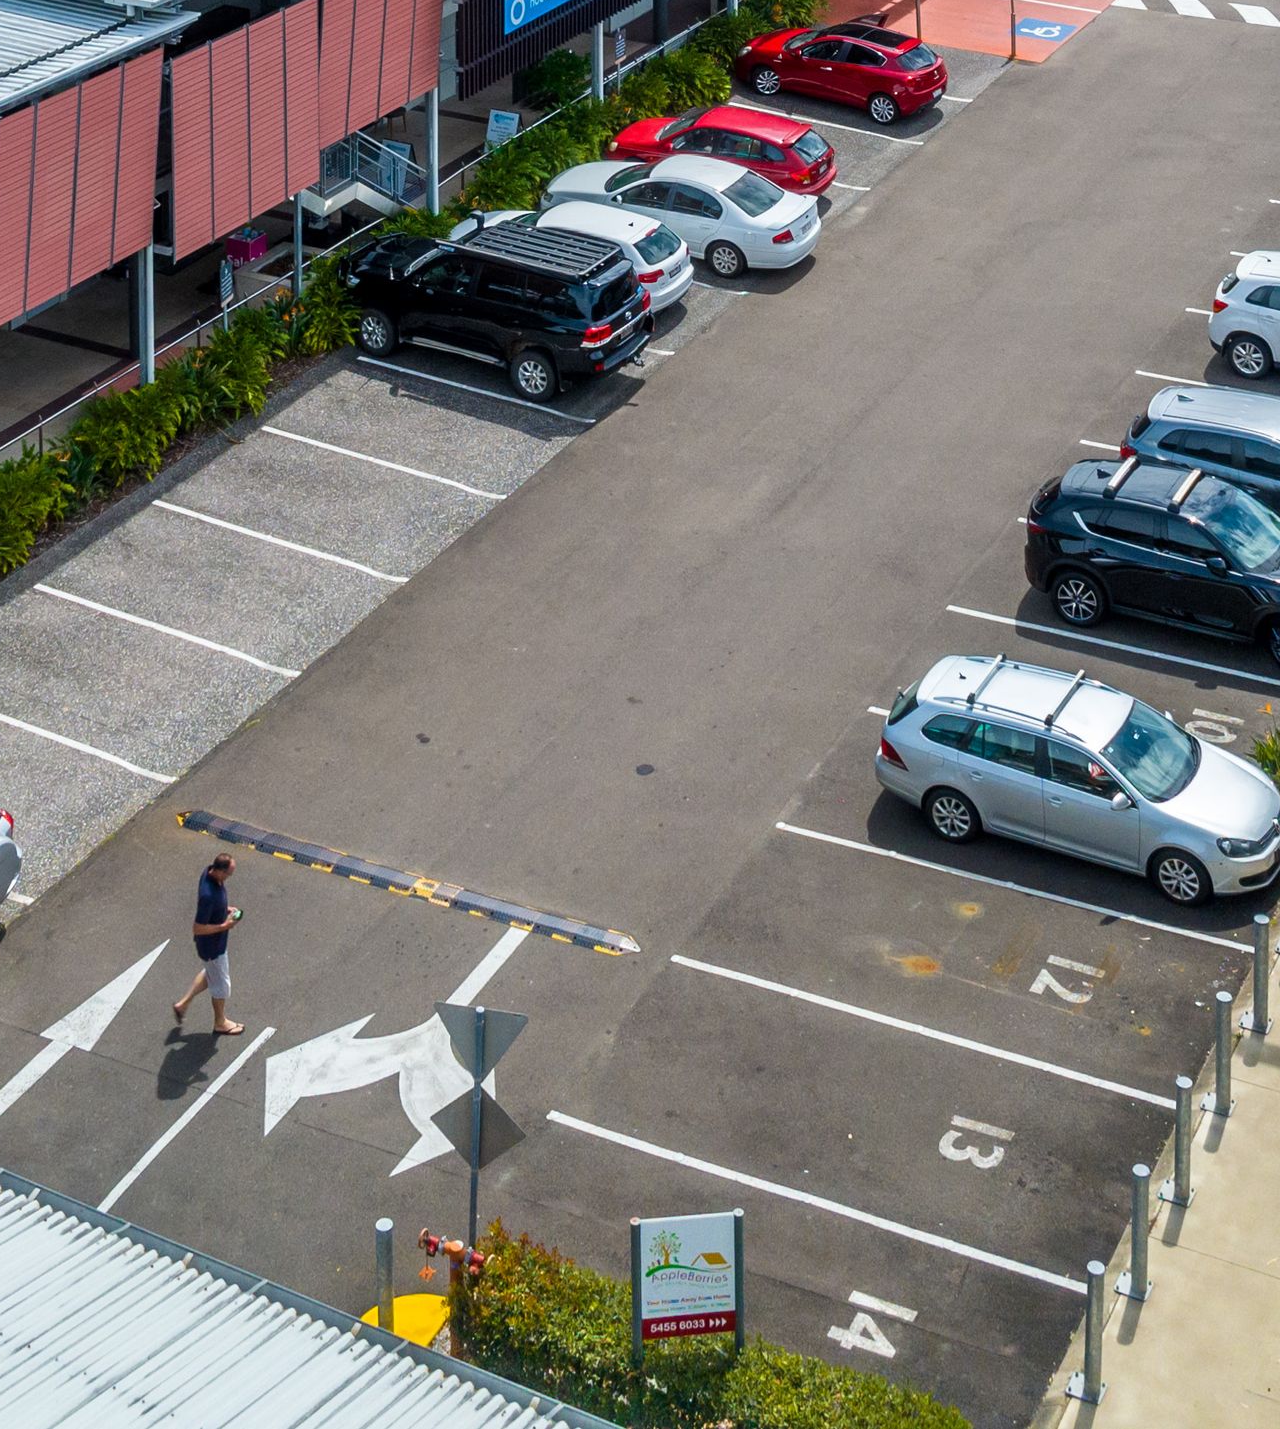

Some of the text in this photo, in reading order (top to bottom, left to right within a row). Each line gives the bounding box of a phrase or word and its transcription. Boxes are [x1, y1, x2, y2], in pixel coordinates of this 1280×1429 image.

[1184, 707, 1245, 744] 10
[1029, 955, 1106, 1004] 12
[939, 1115, 1015, 1170] 13
[651, 1271, 728, 1283] AppleBerries
[650, 1318, 705, 1333] 5455 6033
[828, 1291, 918, 1358] 14
